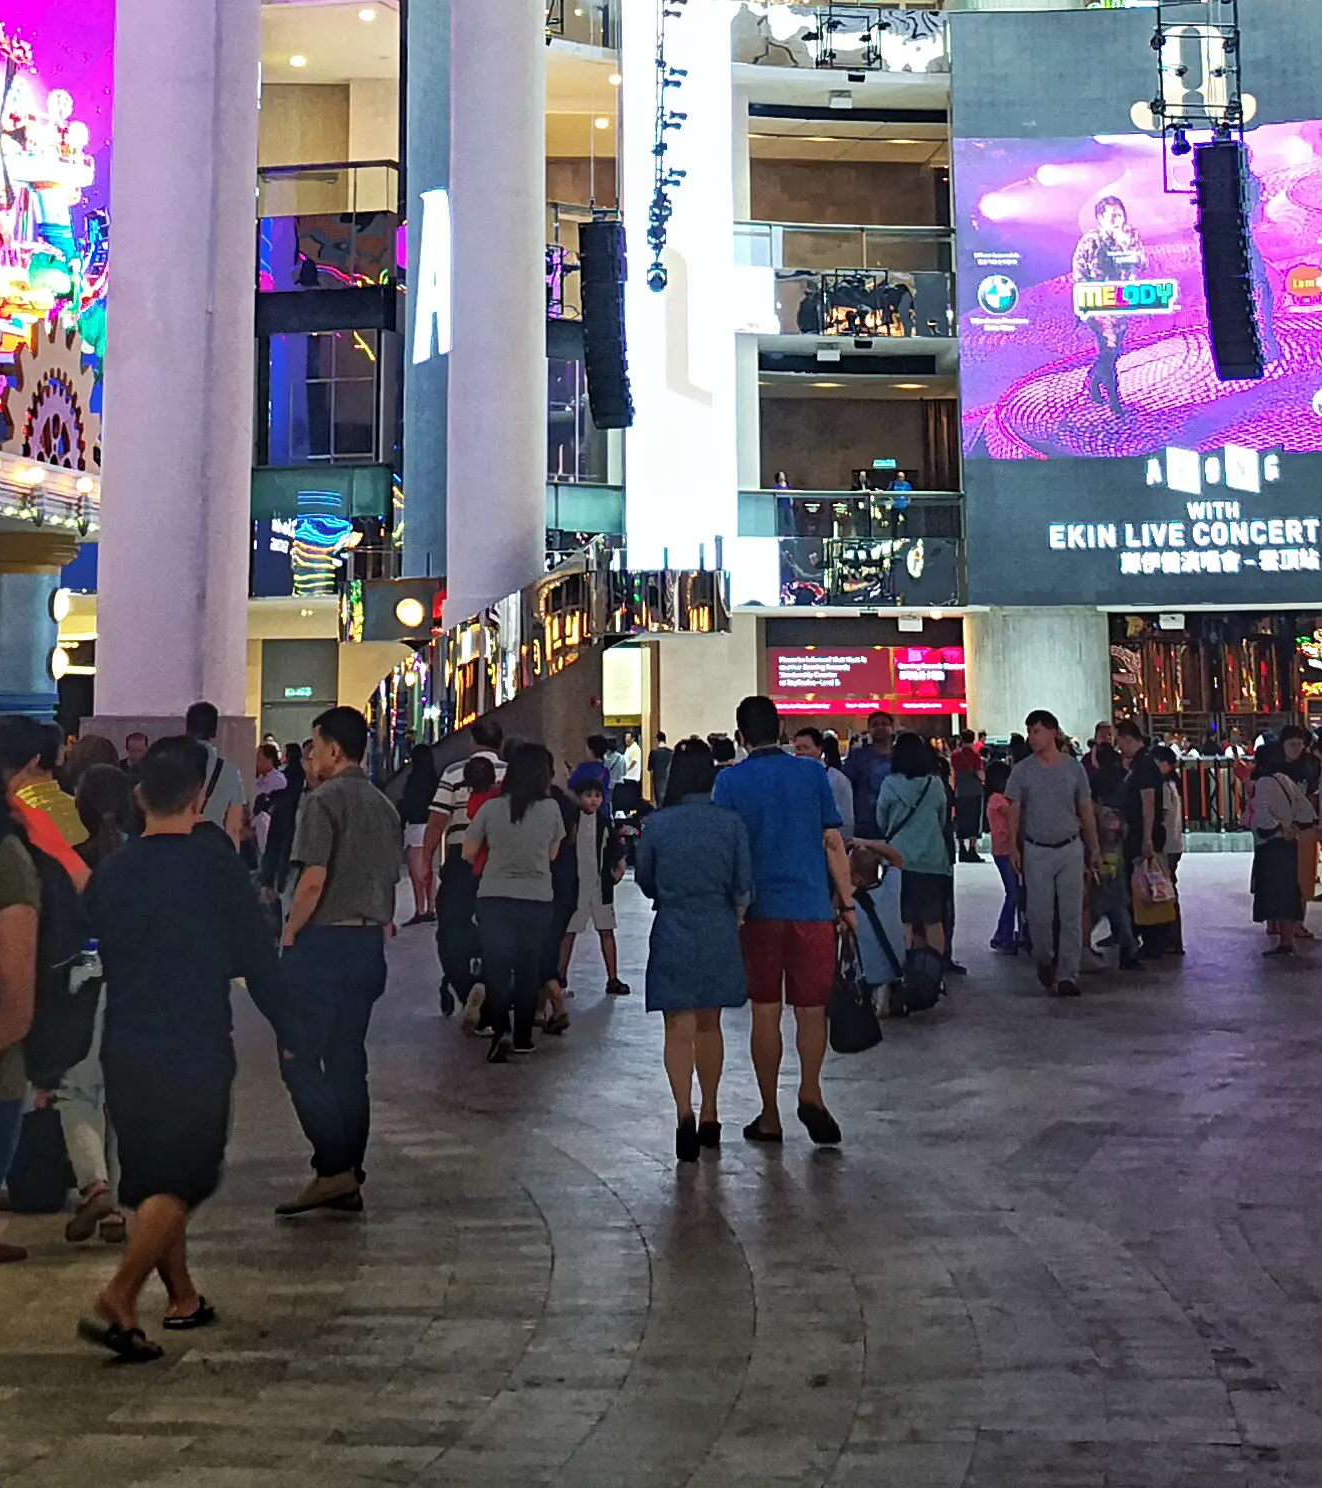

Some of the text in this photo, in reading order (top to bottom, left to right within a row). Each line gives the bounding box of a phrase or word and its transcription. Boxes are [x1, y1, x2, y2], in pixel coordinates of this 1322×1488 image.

[1077, 282, 1175, 309] MELODY
[1186, 501, 1241, 520] WITH
[1048, 522, 1117, 548] EKIN
[1124, 521, 1185, 548] LIVE
[1192, 517, 1320, 546] CONCERT
